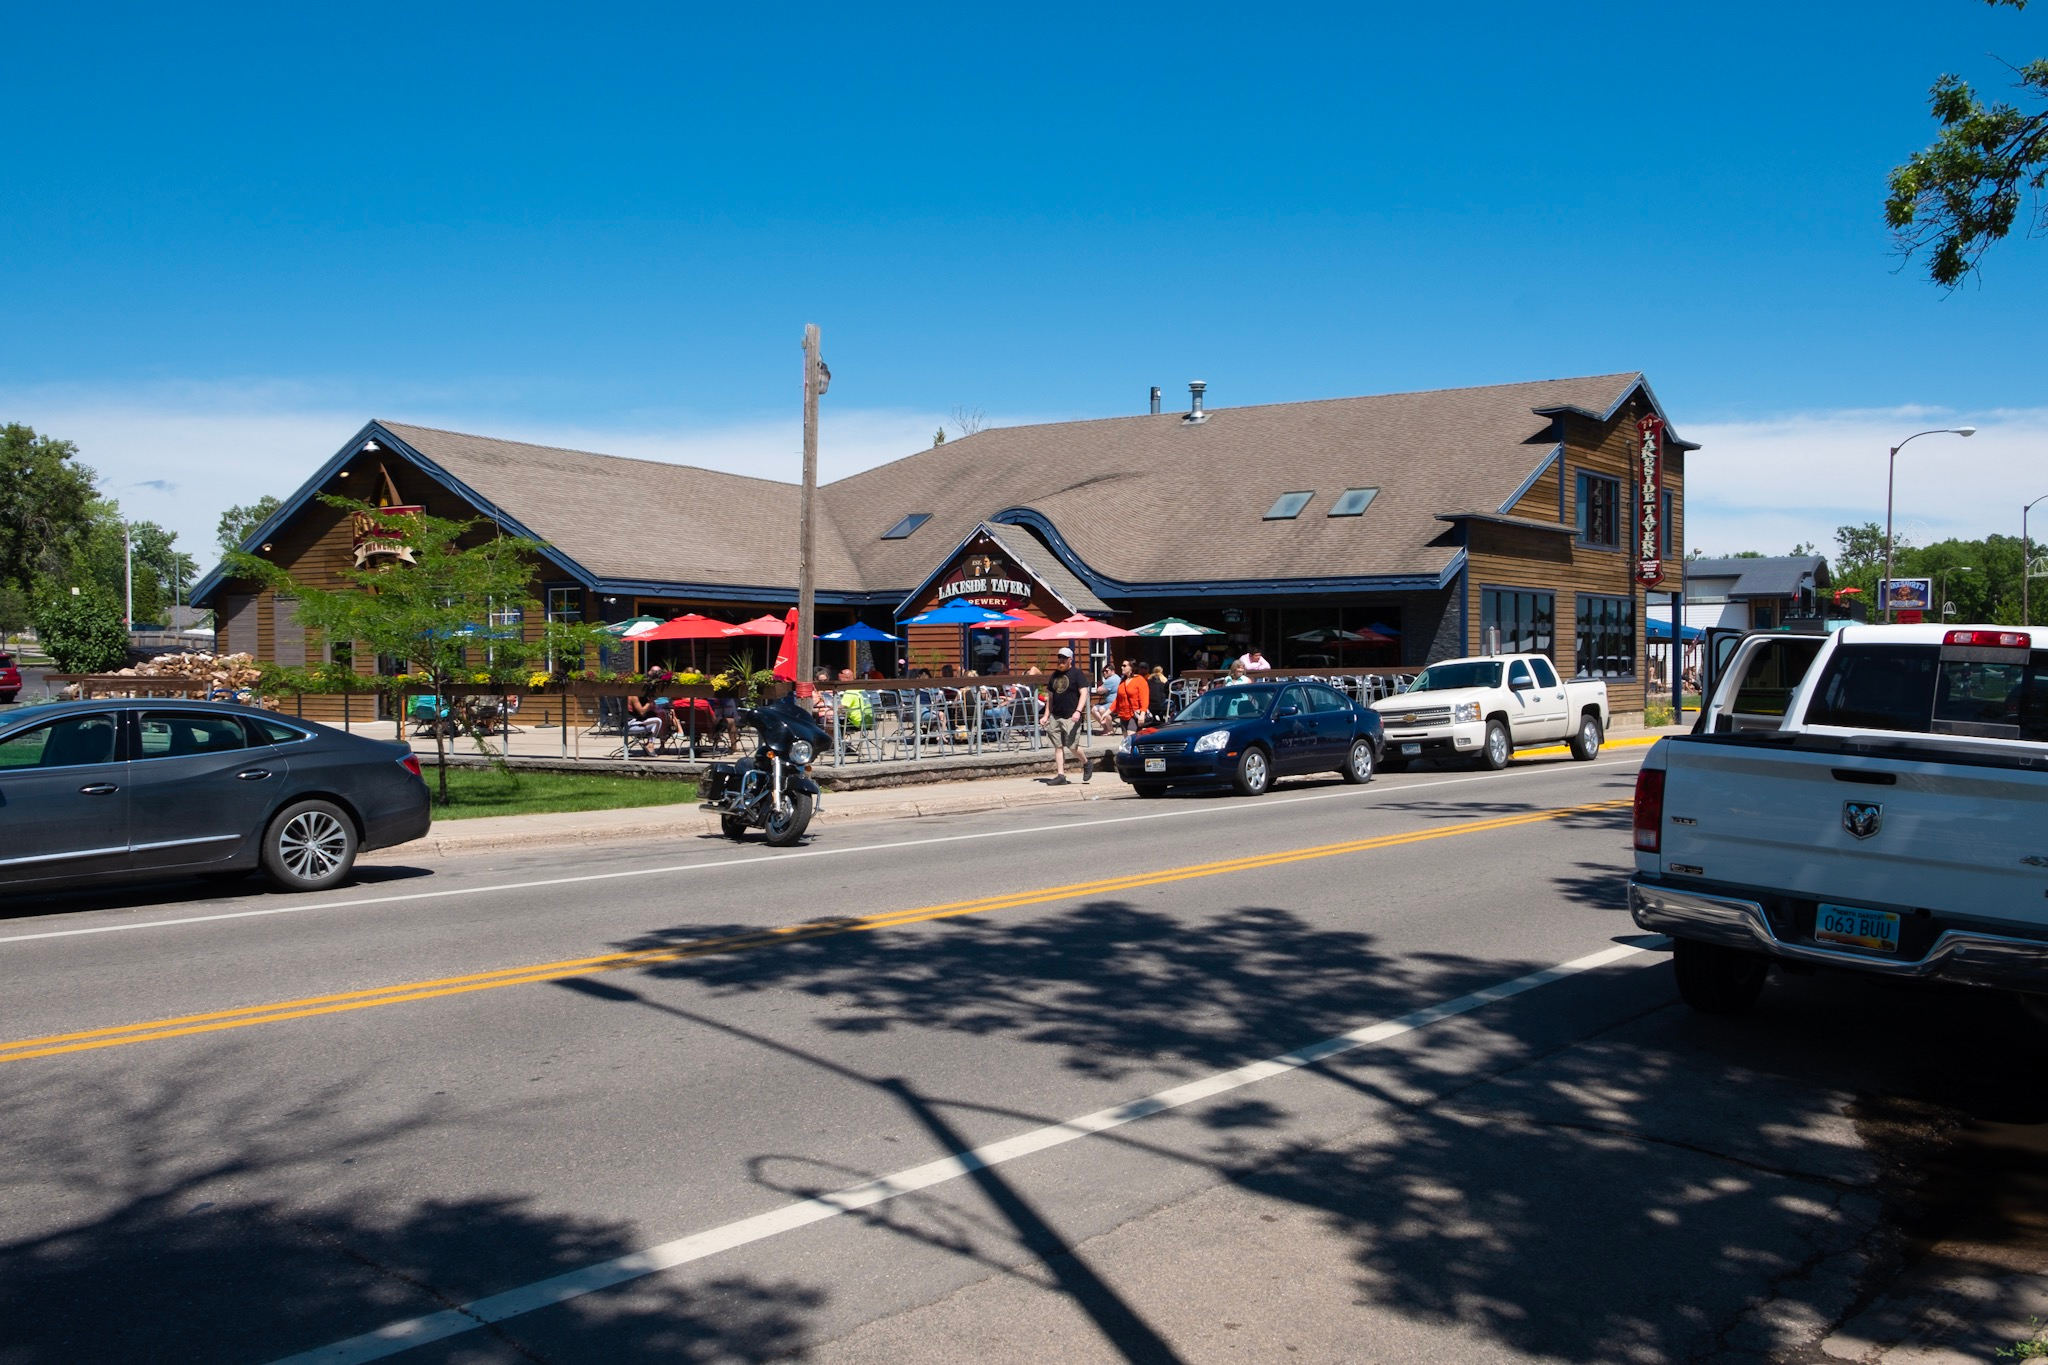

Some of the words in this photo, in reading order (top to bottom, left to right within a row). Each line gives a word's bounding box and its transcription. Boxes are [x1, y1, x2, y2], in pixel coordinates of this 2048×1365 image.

[1641, 431, 1657, 503] LAKESIDE
[1641, 504, 1657, 559] TAVERN
[938, 578, 987, 600] LAKESIDE
[990, 578, 1031, 598] TAVERN
[1825, 915, 1855, 934] 063
[1860, 919, 1891, 939] BUU
